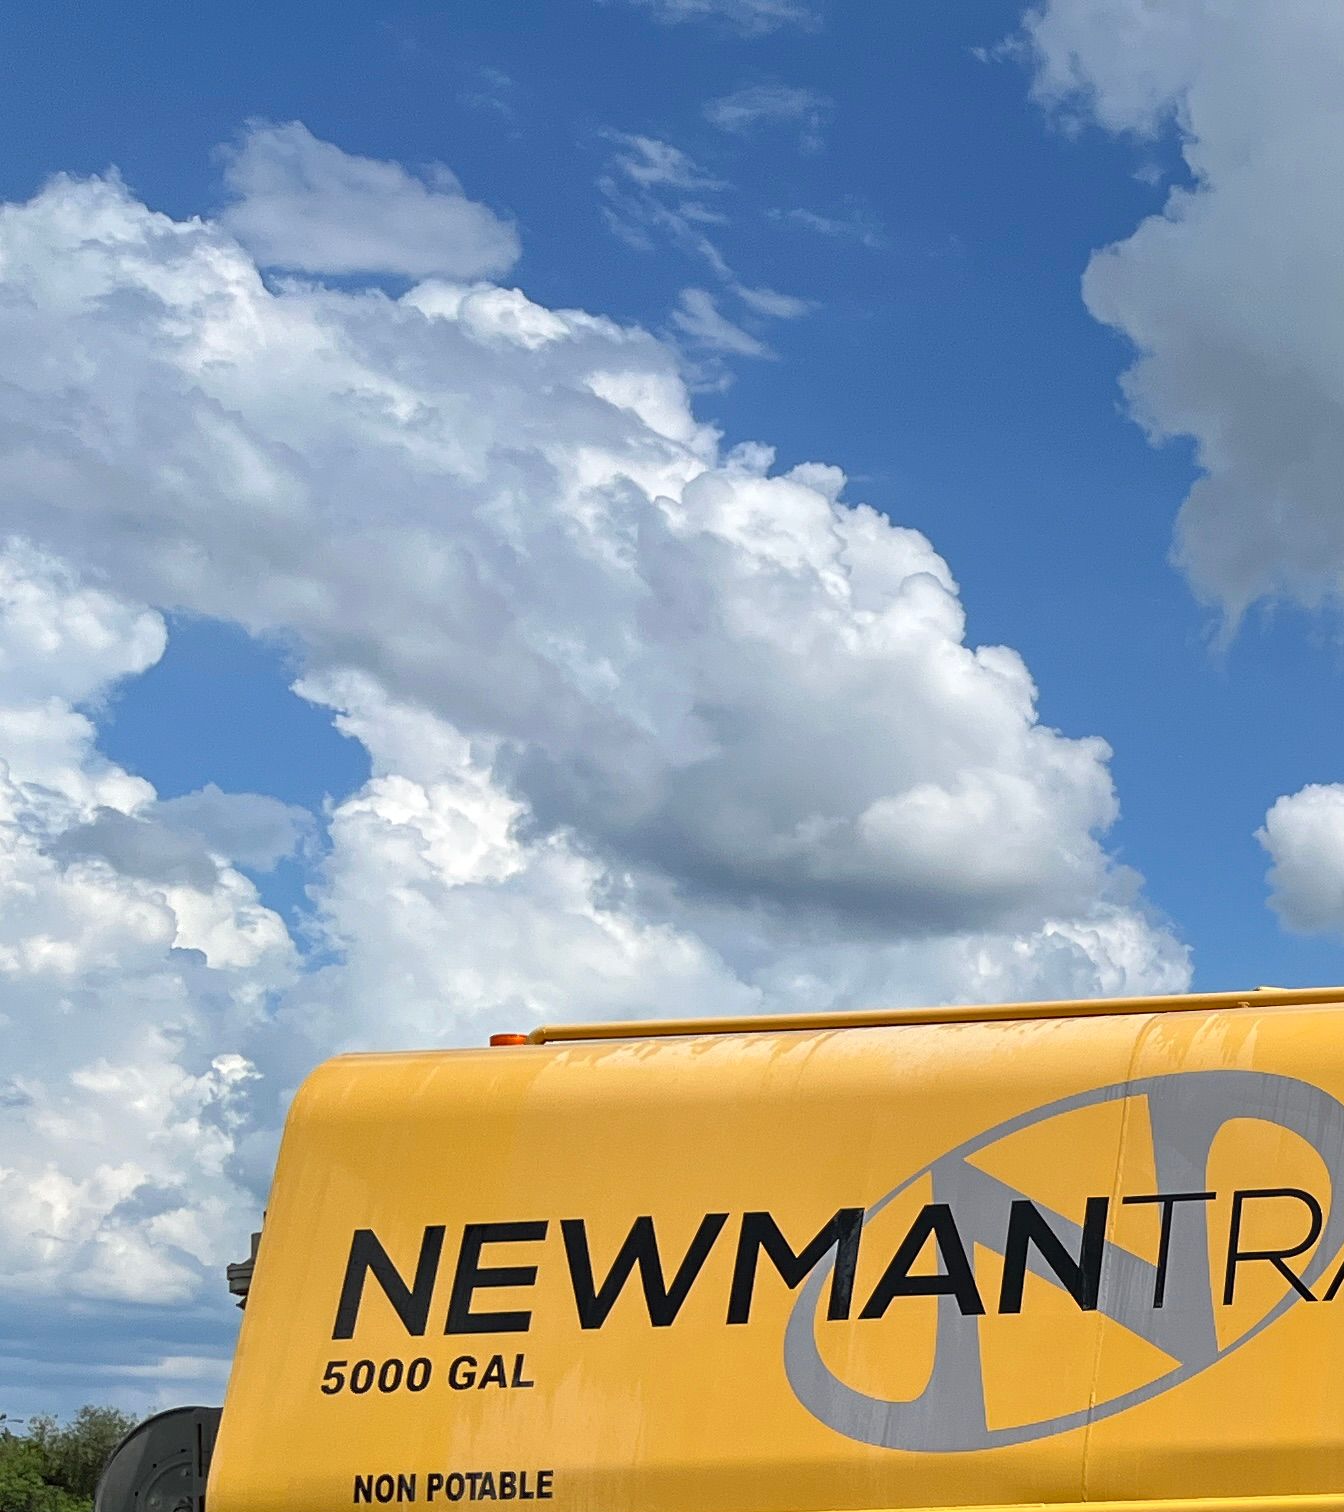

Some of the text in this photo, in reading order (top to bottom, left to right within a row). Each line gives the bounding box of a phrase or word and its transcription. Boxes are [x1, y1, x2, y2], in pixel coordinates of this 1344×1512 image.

[320, 1353, 535, 1395] 5000 GAL
[353, 1469, 554, 1504] NON POTABLE
